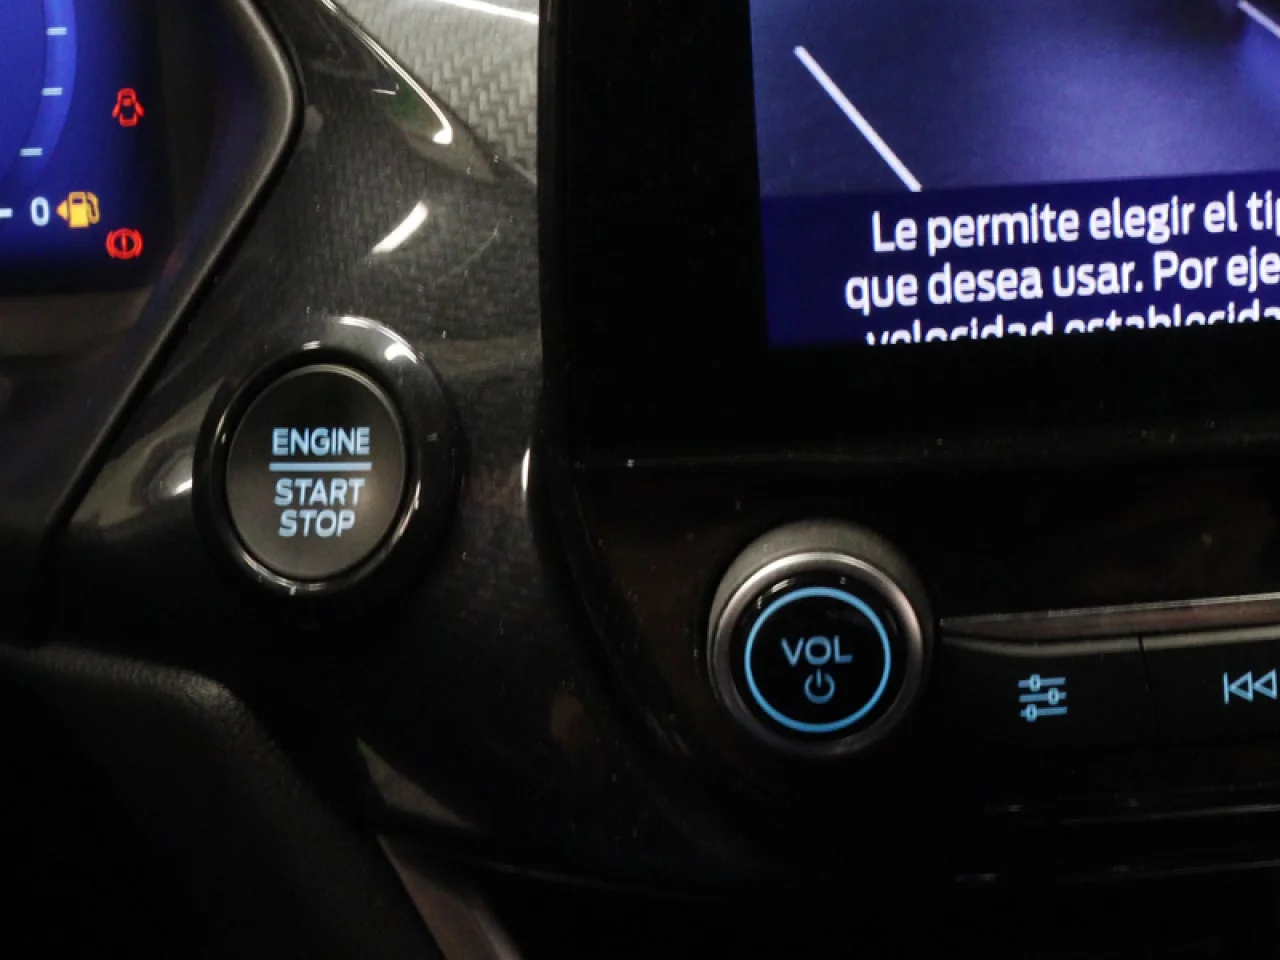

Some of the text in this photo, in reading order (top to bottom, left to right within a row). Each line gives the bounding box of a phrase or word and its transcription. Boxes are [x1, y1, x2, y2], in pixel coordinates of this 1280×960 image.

[30, 196, 50, 227] 0
[871, 210, 918, 253] Le
[927, 202, 1080, 257] permite
[1088, 194, 1196, 245] elegir
[1203, 190, 1238, 233] el
[845, 273, 919, 316] que
[927, 261, 1044, 305] desea
[1052, 261, 1144, 298] usar.
[1153, 250, 1219, 292] Por
[271, 426, 371, 457] ENGINE
[273, 477, 365, 507] START
[277, 508, 356, 538] STOP
[780, 635, 853, 667] VOL
